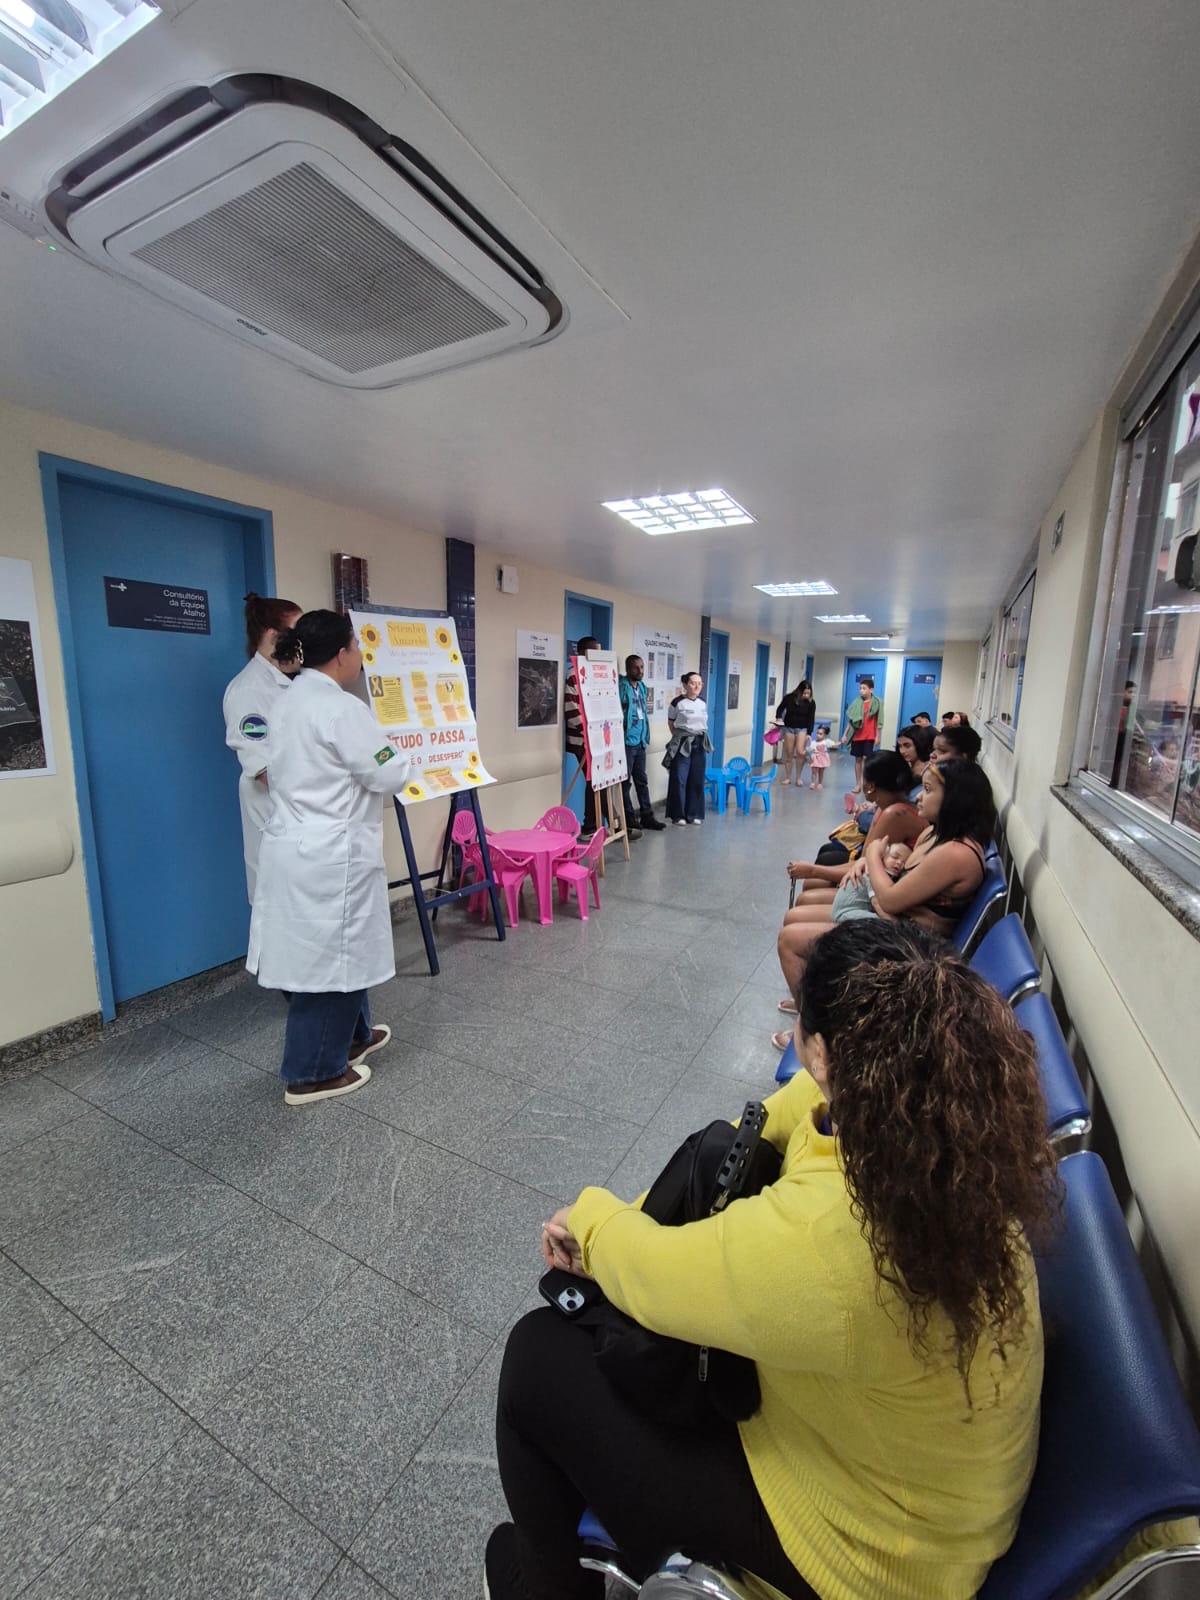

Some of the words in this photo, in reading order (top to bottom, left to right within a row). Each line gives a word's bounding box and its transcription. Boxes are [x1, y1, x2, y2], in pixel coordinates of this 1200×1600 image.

[163, 589, 204, 601] Consultório
[169, 599, 179, 607] da
[180, 600, 205, 610] Equipe
[183, 608, 206, 618] Atalho
[430, 729, 466, 746] PASSA
